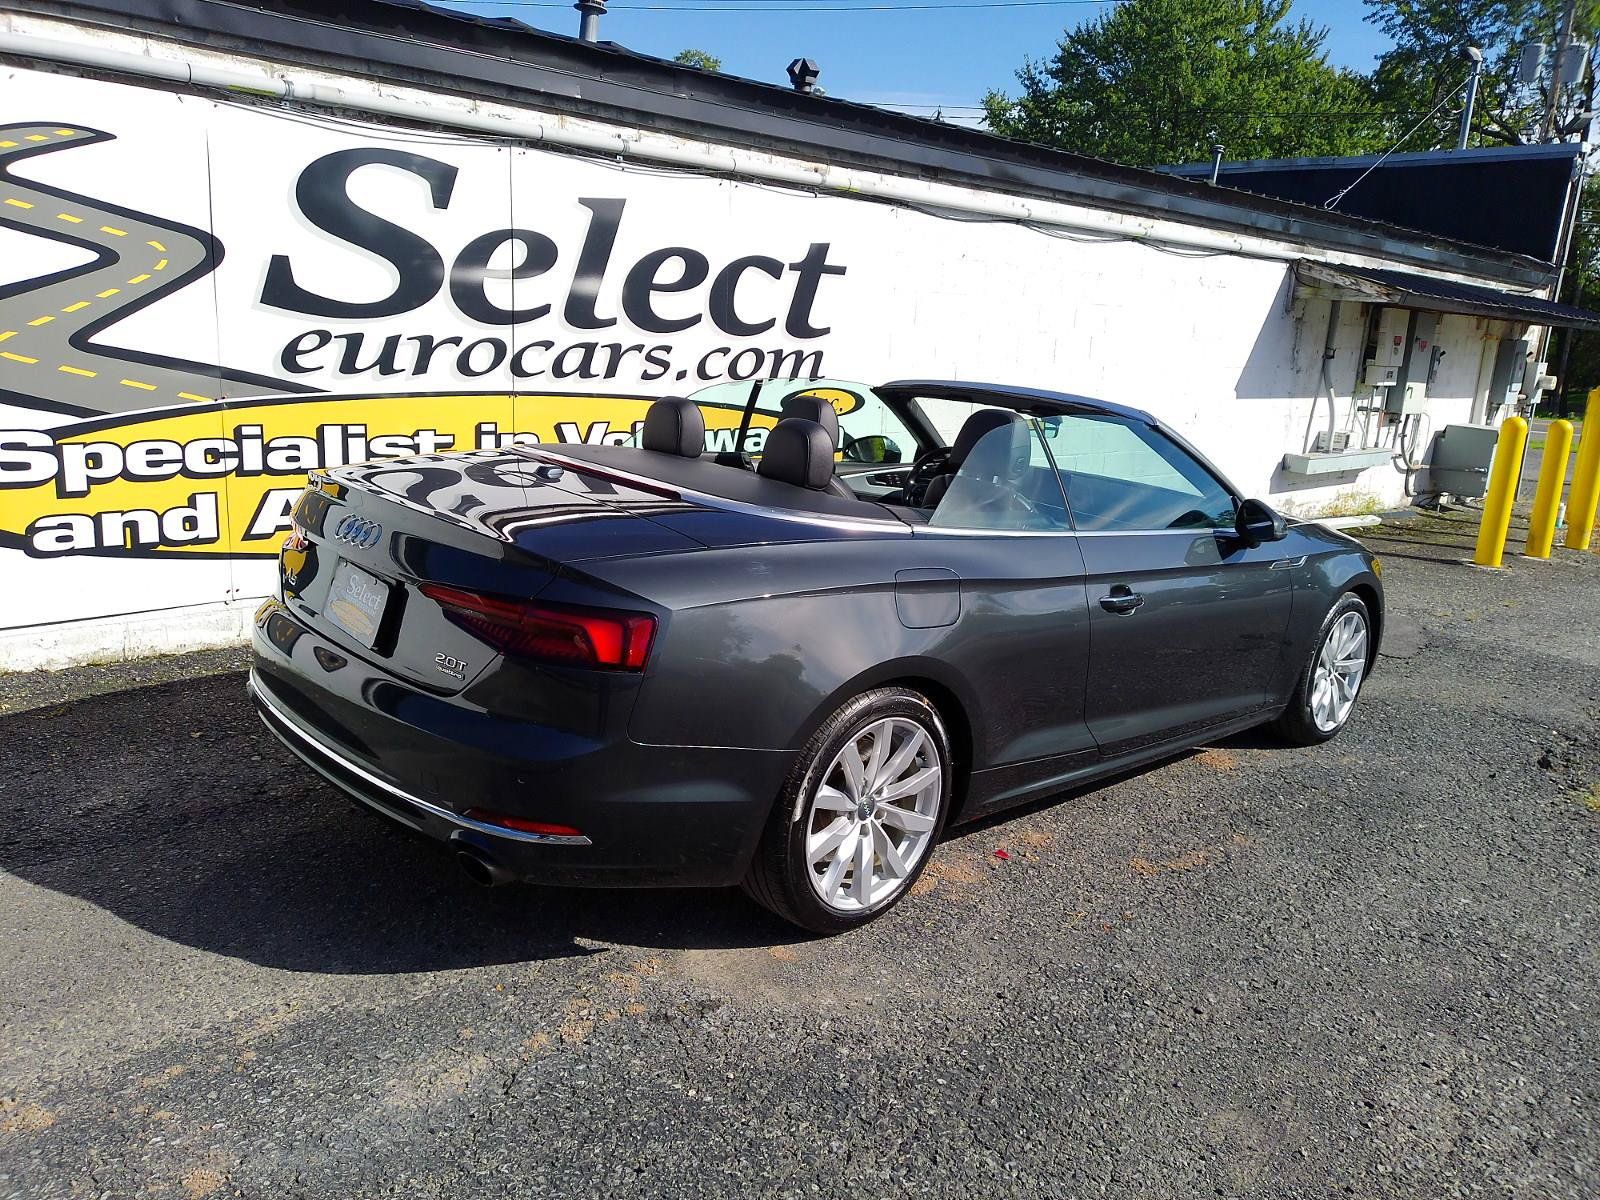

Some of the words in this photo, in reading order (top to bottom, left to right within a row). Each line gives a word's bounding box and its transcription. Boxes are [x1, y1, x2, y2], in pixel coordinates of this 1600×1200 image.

[260, 147, 847, 338] Select
[281, 329, 825, 381] eurocars.com
[0, 424, 455, 497] Specialist
[26, 492, 219, 556] and
[346, 574, 382, 610] Select
[434, 651, 468, 671] 2.0T
